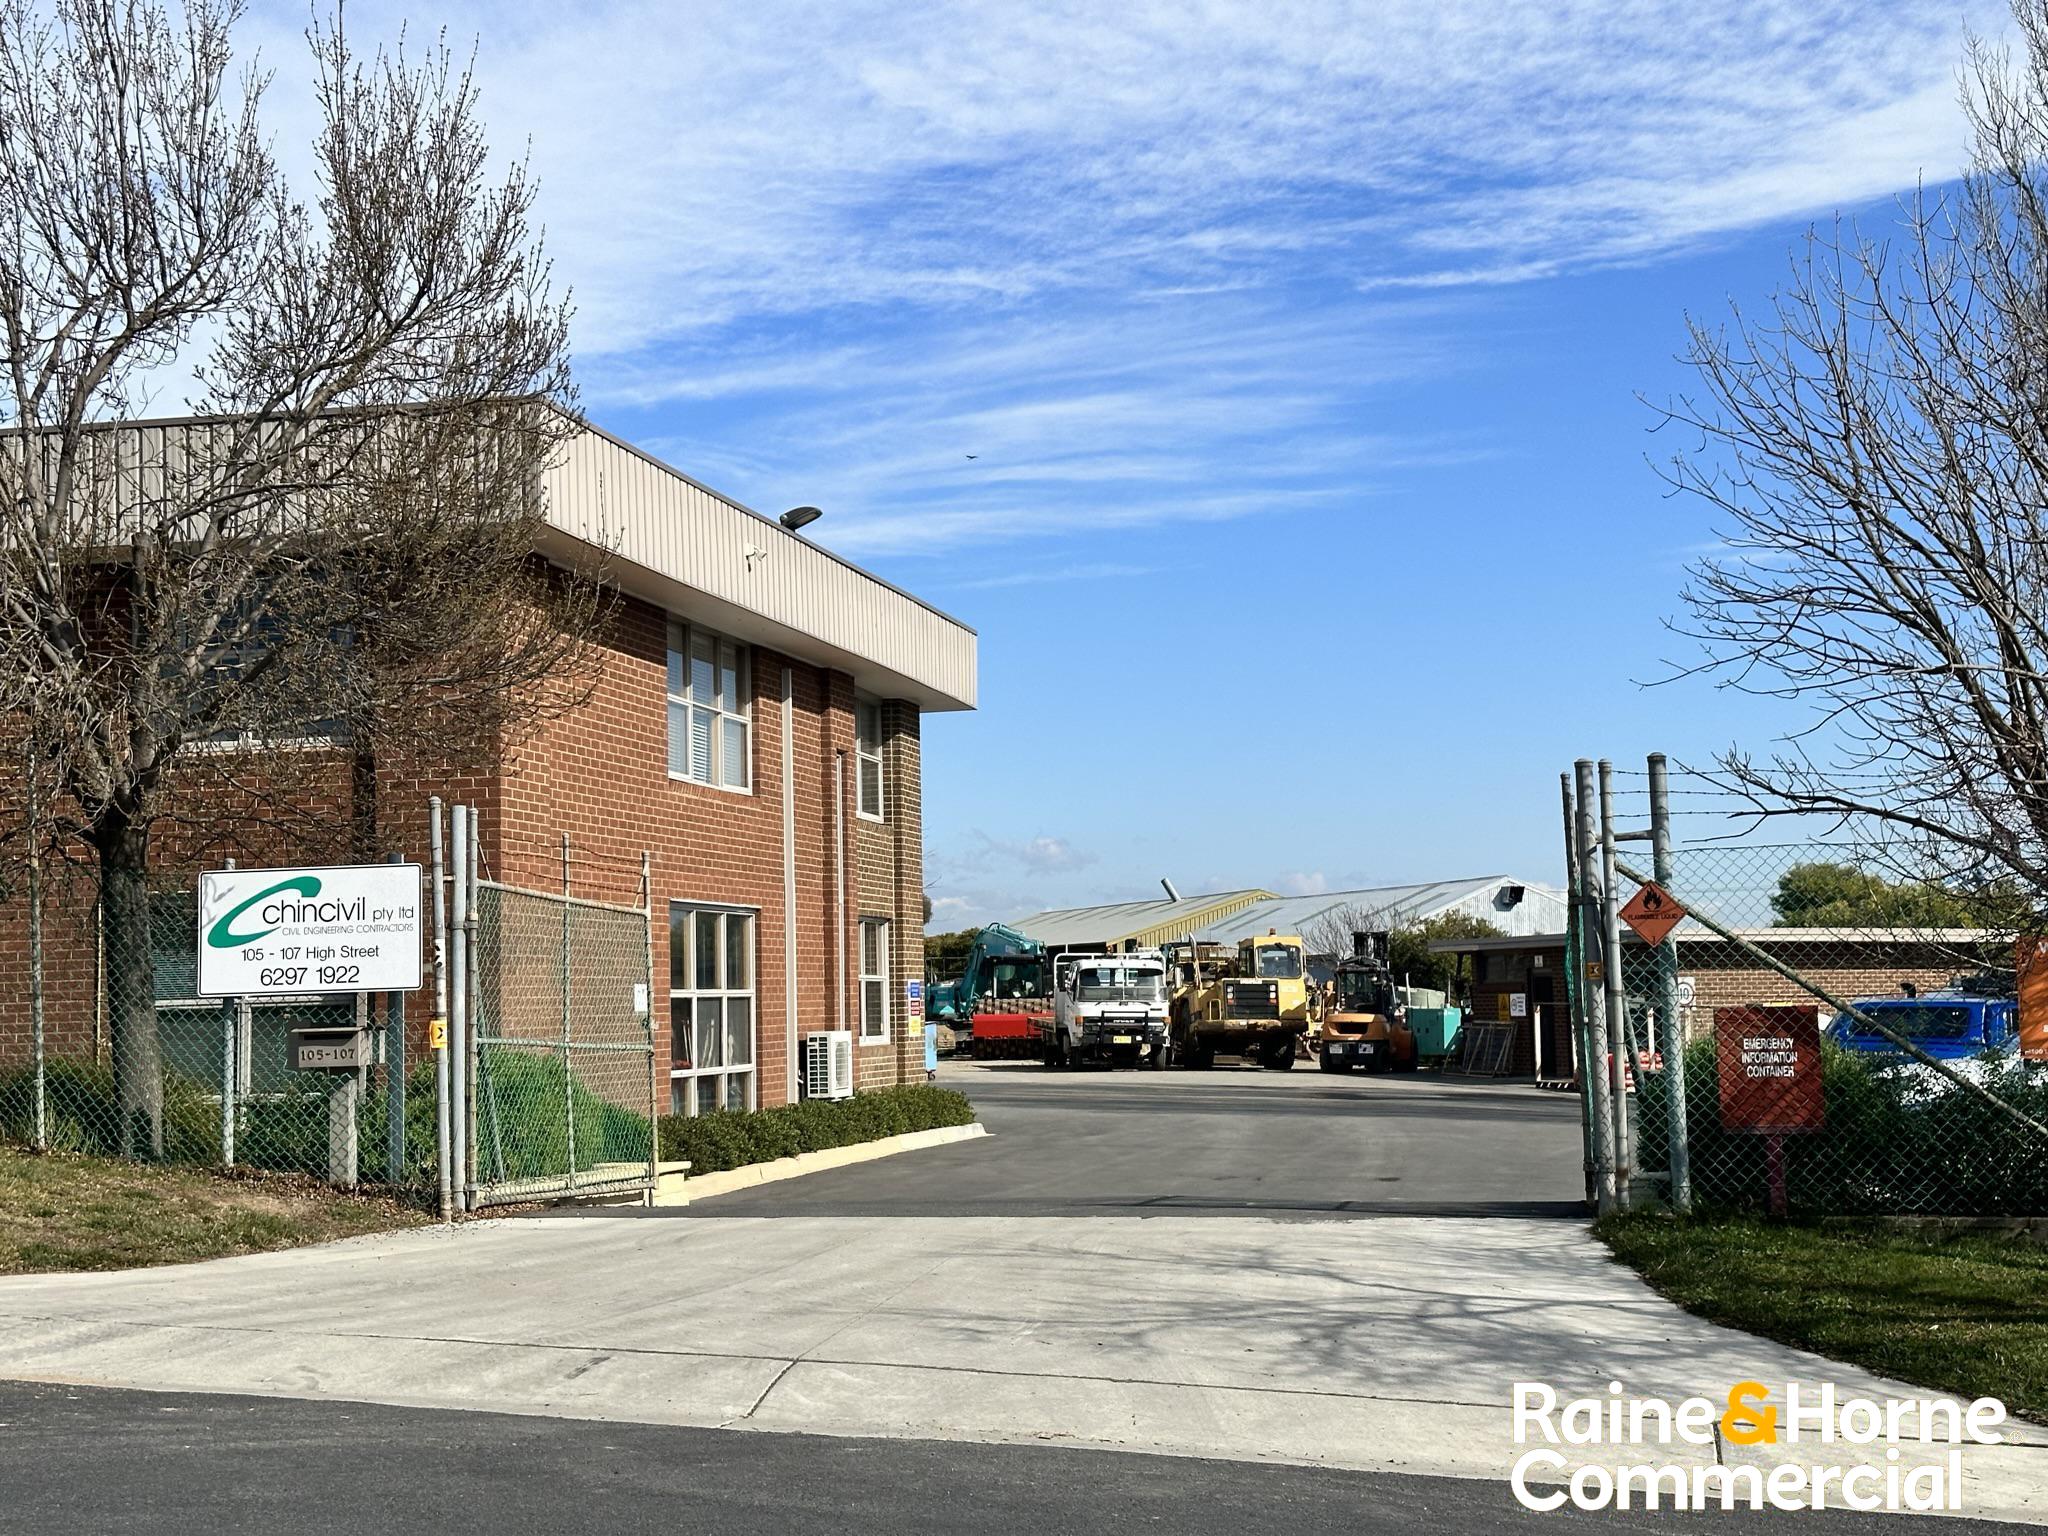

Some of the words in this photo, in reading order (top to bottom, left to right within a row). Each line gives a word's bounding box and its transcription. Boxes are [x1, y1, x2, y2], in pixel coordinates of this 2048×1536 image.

[372, 909, 394, 923] pty
[399, 906, 414, 919] ltd
[281, 927, 301, 937] CIVIL
[303, 925, 354, 936] ENGINEERING
[356, 923, 414, 934] CONTRACTORS
[241, 948, 264, 961] 105
[280, 947, 301, 960] 107
[306, 946, 336, 962] High
[340, 945, 380, 958] Street
[260, 967, 308, 986] 6297
[316, 965, 360, 985] 1922
[1743, 1037, 1794, 1050] EMERGENCY
[301, 1047, 356, 1061] 105-107
[1741, 1051, 1798, 1063] INFORMATION
[1746, 1065, 1795, 1078] CONTAINER
